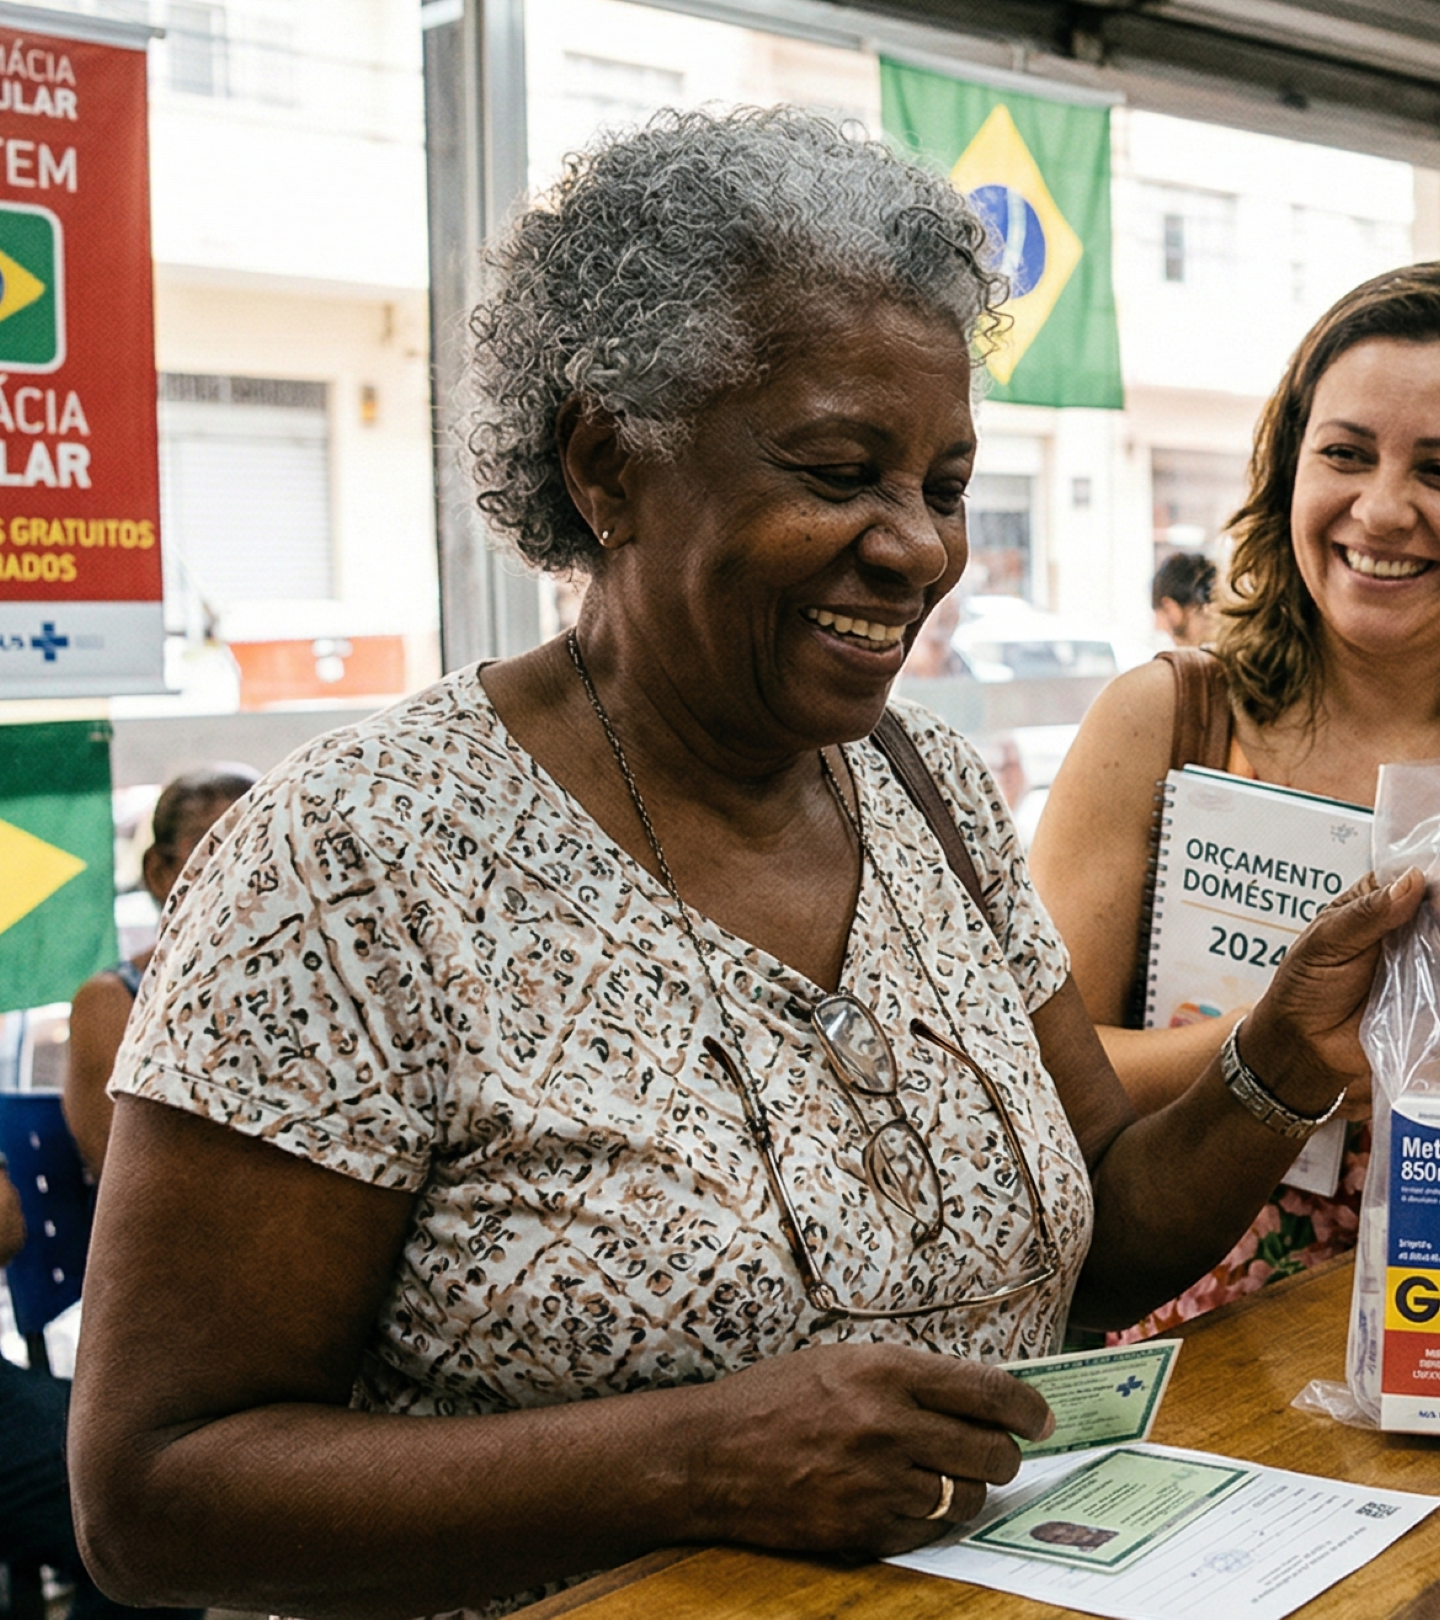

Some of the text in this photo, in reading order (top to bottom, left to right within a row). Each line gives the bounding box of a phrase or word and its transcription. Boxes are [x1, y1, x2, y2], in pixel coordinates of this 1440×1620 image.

[0, 137, 77, 193] EM
[9, 516, 155, 549] GRATUITOS
[1186, 838, 1343, 895] ORÇAMENTO
[1208, 926, 1288, 968] 2024
